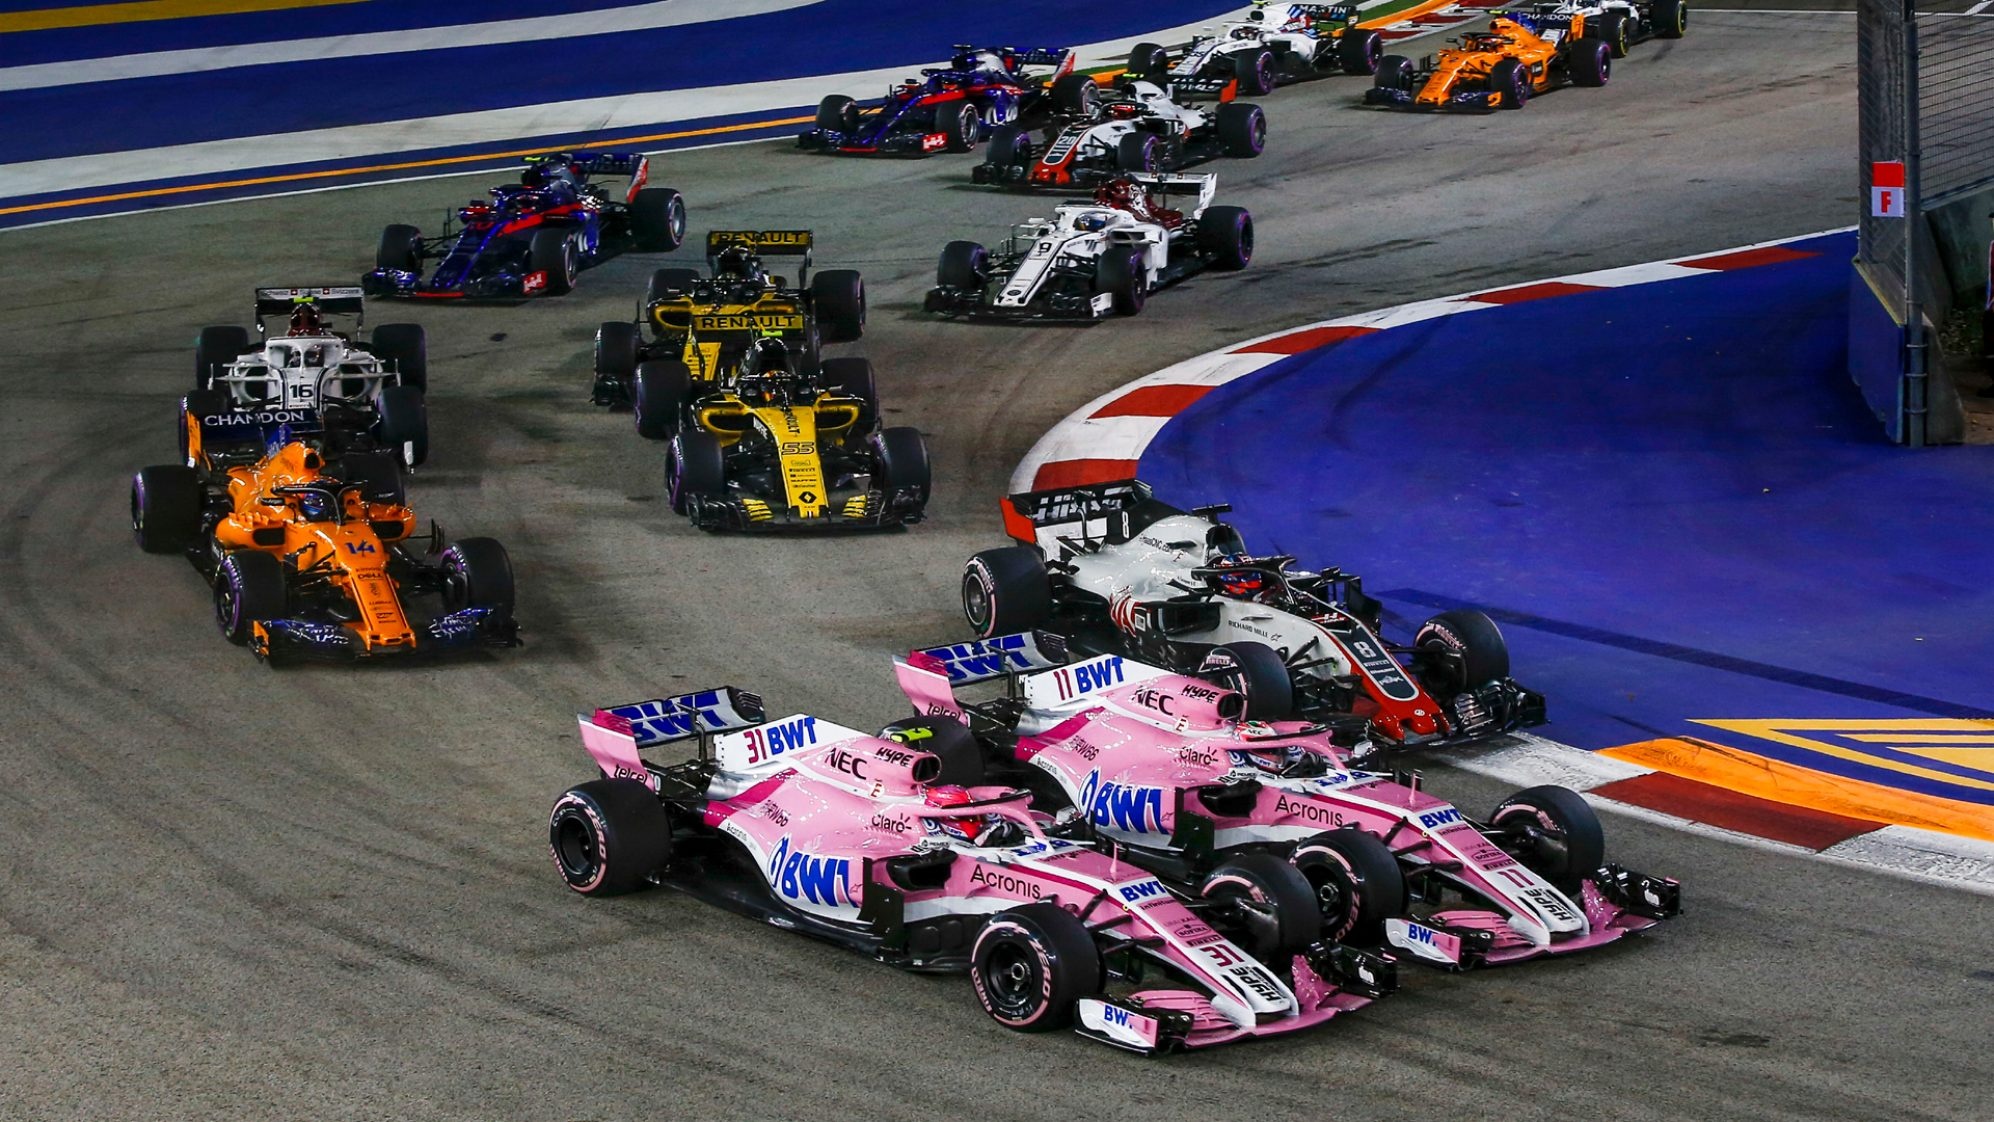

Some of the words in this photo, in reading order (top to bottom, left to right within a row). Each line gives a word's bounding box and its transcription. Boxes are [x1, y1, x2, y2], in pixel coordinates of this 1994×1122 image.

[1060, 136, 1077, 144] 20
[1881, 191, 1892, 213] F
[1039, 242, 1053, 255] 9
[702, 316, 796, 328] RENAULT
[290, 384, 314, 398] 16
[781, 442, 815, 455] 55
[1122, 511, 1130, 538] 8
[346, 540, 375, 557] 14
[925, 634, 1034, 681] BWT
[1354, 641, 1377, 658] 8
[1053, 669, 1073, 700] 11
[1074, 656, 1124, 694] BWT
[1132, 687, 1174, 716] NEC
[1181, 684, 1220, 704] HYPE
[611, 691, 728, 740] BWT
[743, 729, 767, 764] 31
[767, 716, 817, 755] BWT
[824, 747, 868, 780] NEC
[876, 747, 914, 767] HYPE
[1180, 746, 1213, 765] Claro
[1274, 794, 1344, 827] Acronis
[1420, 809, 1462, 829] BWT
[872, 814, 906, 833] Claro
[970, 864, 1041, 899] Acronis
[1497, 869, 1535, 888] 11
[1119, 880, 1166, 902] BWT
[1524, 888, 1573, 921] HYPE
[1200, 944, 1245, 967] 31
[1229, 966, 1281, 1001] HYPE
